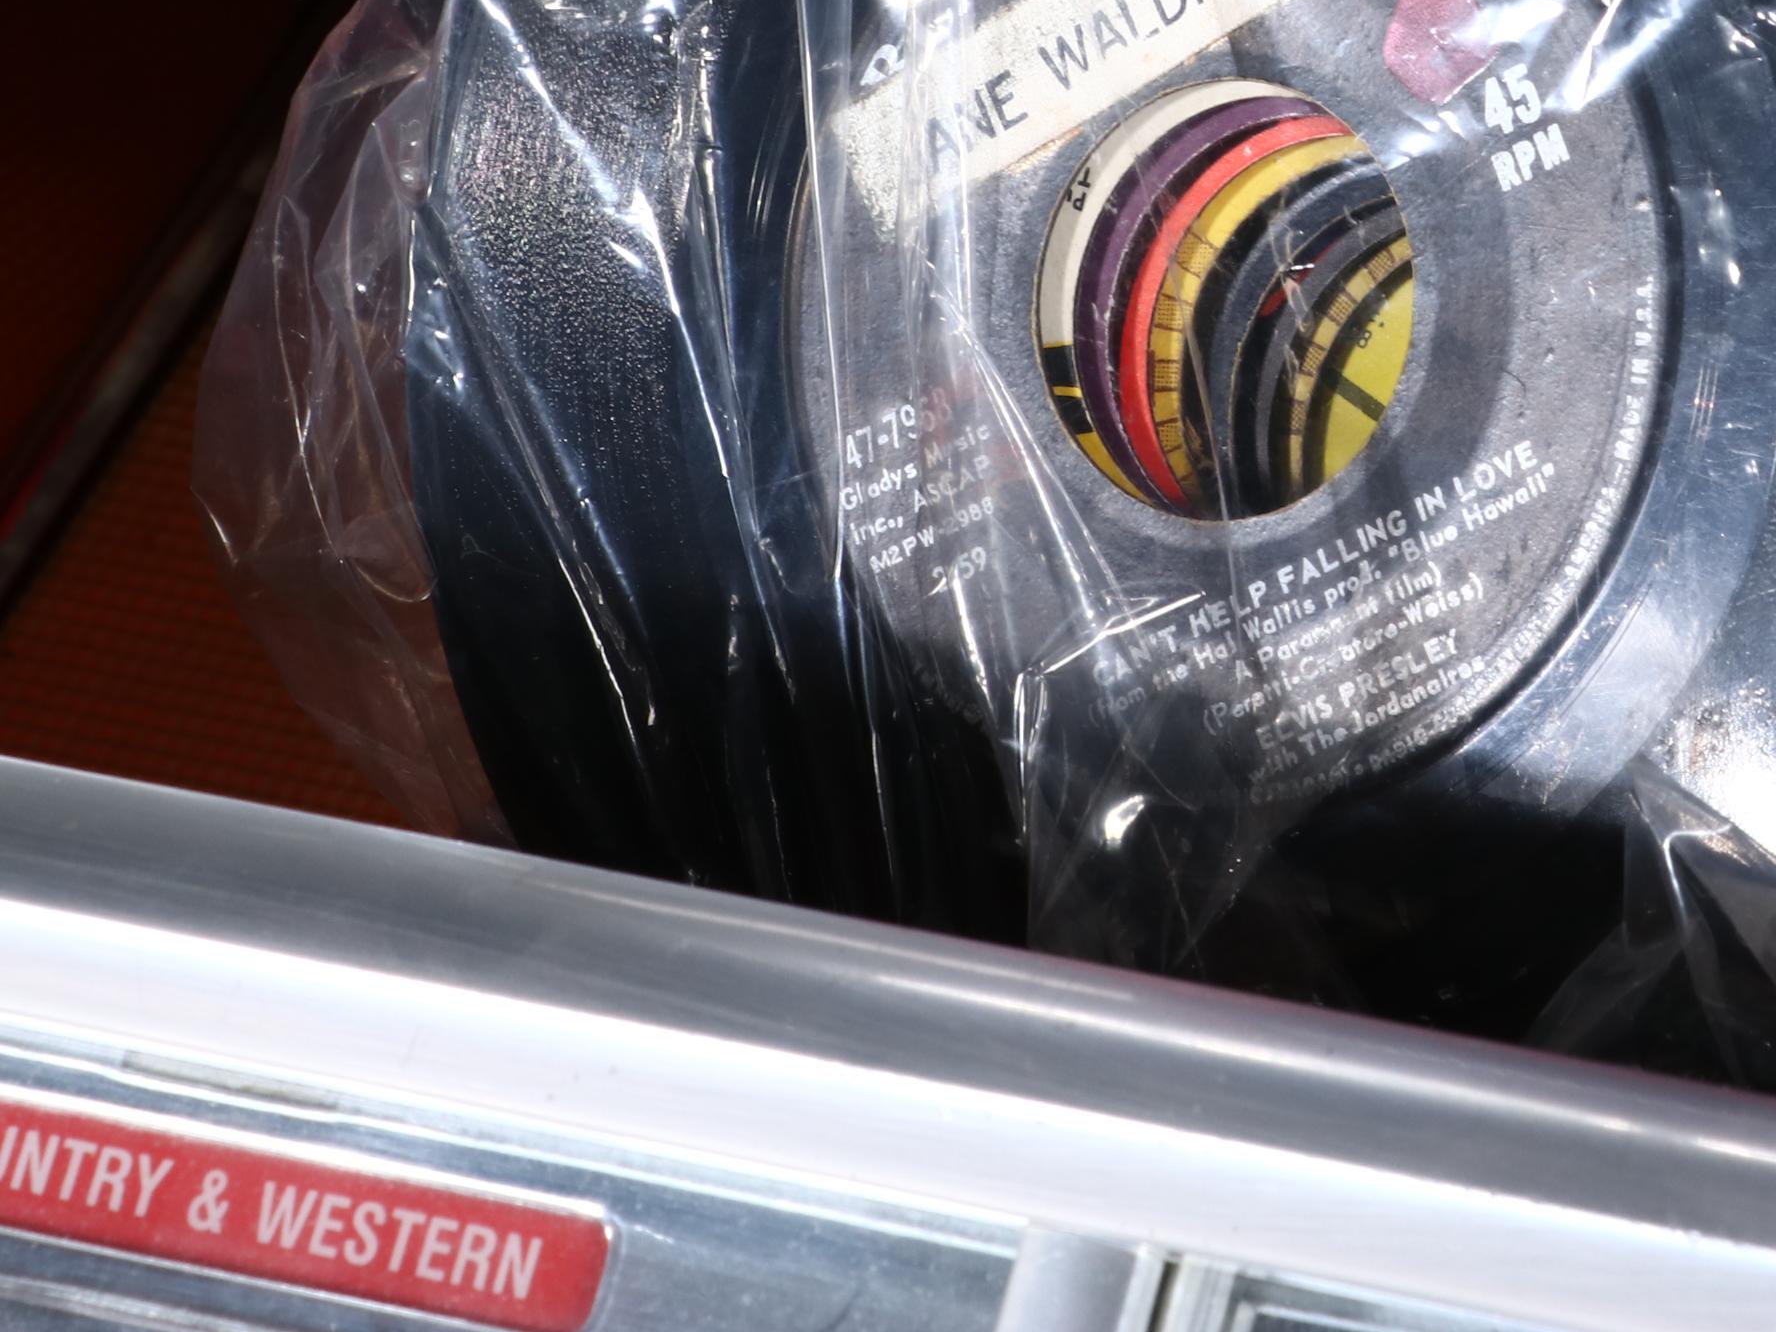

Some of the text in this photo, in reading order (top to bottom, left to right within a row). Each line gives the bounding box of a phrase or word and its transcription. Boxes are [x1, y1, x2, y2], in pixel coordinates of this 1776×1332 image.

[1484, 62, 1542, 134] 45
[1490, 122, 1571, 192] RPM
[840, 424, 991, 511] Gladys Msic
[913, 454, 992, 514] ASCAP
[1188, 579, 1267, 639] HELP
[1276, 509, 1408, 595] FALLING
[1413, 485, 1448, 522] IN
[1452, 439, 1539, 503] LOVE
[1192, 630, 1239, 670] Hal
[1242, 598, 1317, 643] Wallis
[1234, 659, 1254, 686] A
[1383, 559, 1442, 606] film)
[1255, 693, 1334, 751] ELVIS
[1337, 628, 1458, 709] PRESLEY
[1298, 726, 1349, 756] The
[1347, 654, 1486, 734] Jordanaires
[187, 1169, 230, 1235] &
[255, 1179, 543, 1300] WESTERN
